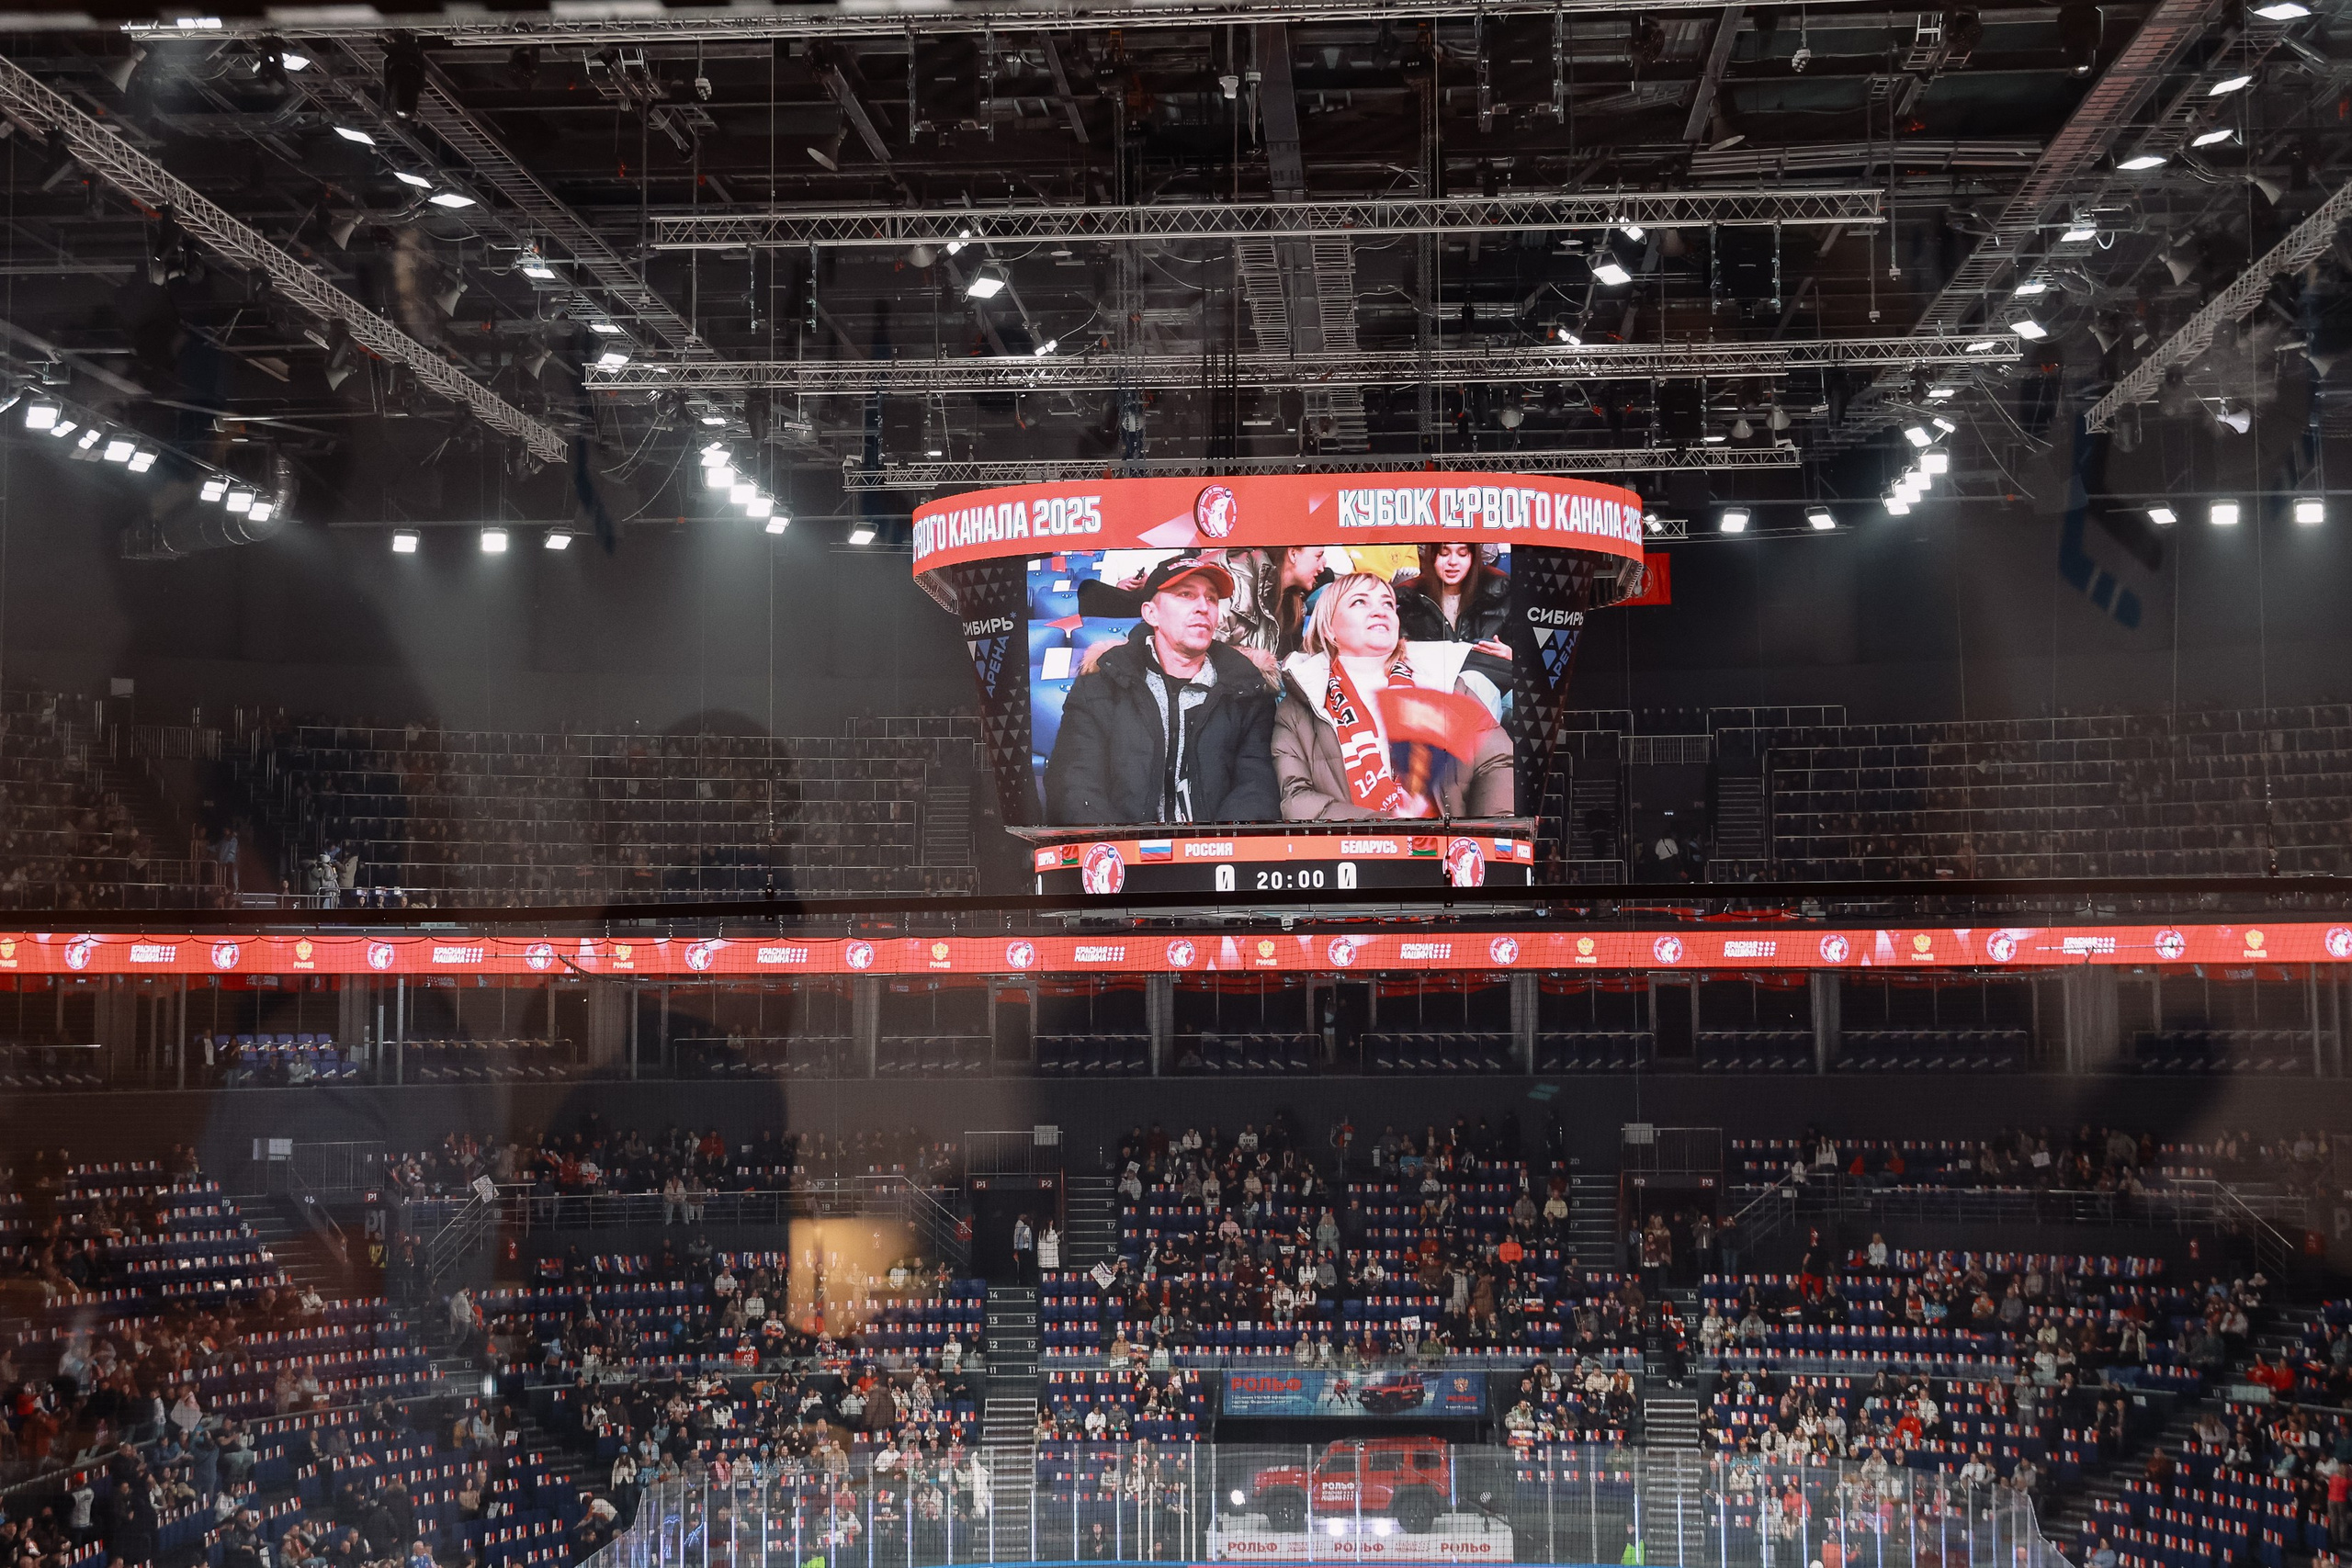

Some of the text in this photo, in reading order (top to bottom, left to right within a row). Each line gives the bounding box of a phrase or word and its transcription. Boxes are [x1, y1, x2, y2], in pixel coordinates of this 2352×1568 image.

[1338, 488, 1437, 527] КУБОК
[1555, 493, 1623, 539] КАНАЛА
[948, 501, 1030, 548] КАНАЛА
[1033, 495, 1102, 537] 2025
[1527, 606, 1584, 626] СИБИРЬ
[962, 616, 1014, 636] СИБИРЬ
[985, 636, 1010, 698] АРЕНА
[1184, 842, 1234, 858] РОССИЯ
[1287, 843, 1293, 853] 1
[1340, 840, 1397, 854] БЕЛАРУСЬ
[1256, 870, 1324, 889] 20:00
[759, 947, 790, 955] КРАСНАЯ
[1402, 943, 1433, 952] КРАСНАЯ
[433, 954, 465, 963] МАШИНА
[1105, 1179, 1114, 1187] 19
[1106, 1222, 1116, 1230] 17
[1107, 1245, 1116, 1253] 16
[1026, 1291, 1035, 1299] 14
[1687, 1292, 1696, 1300] 14
[989, 1316, 998, 1325] 13
[1026, 1315, 1036, 1324] 13
[1687, 1315, 1696, 1324] 13
[989, 1340, 998, 1348] 12
[1026, 1340, 1036, 1348] 12
[989, 1366, 997, 1374] 11
[1028, 1366, 1035, 1374] 11
[1647, 1365, 1656, 1374] 11
[1687, 1366, 1694, 1374] 11
[1231, 1377, 1302, 1392] РОЛЬФ
[1322, 1482, 1355, 1490] РОЛЬФ
[1227, 1541, 1278, 1552] РОЛЬФ
[1441, 1541, 1491, 1552] РОЛЬФ
